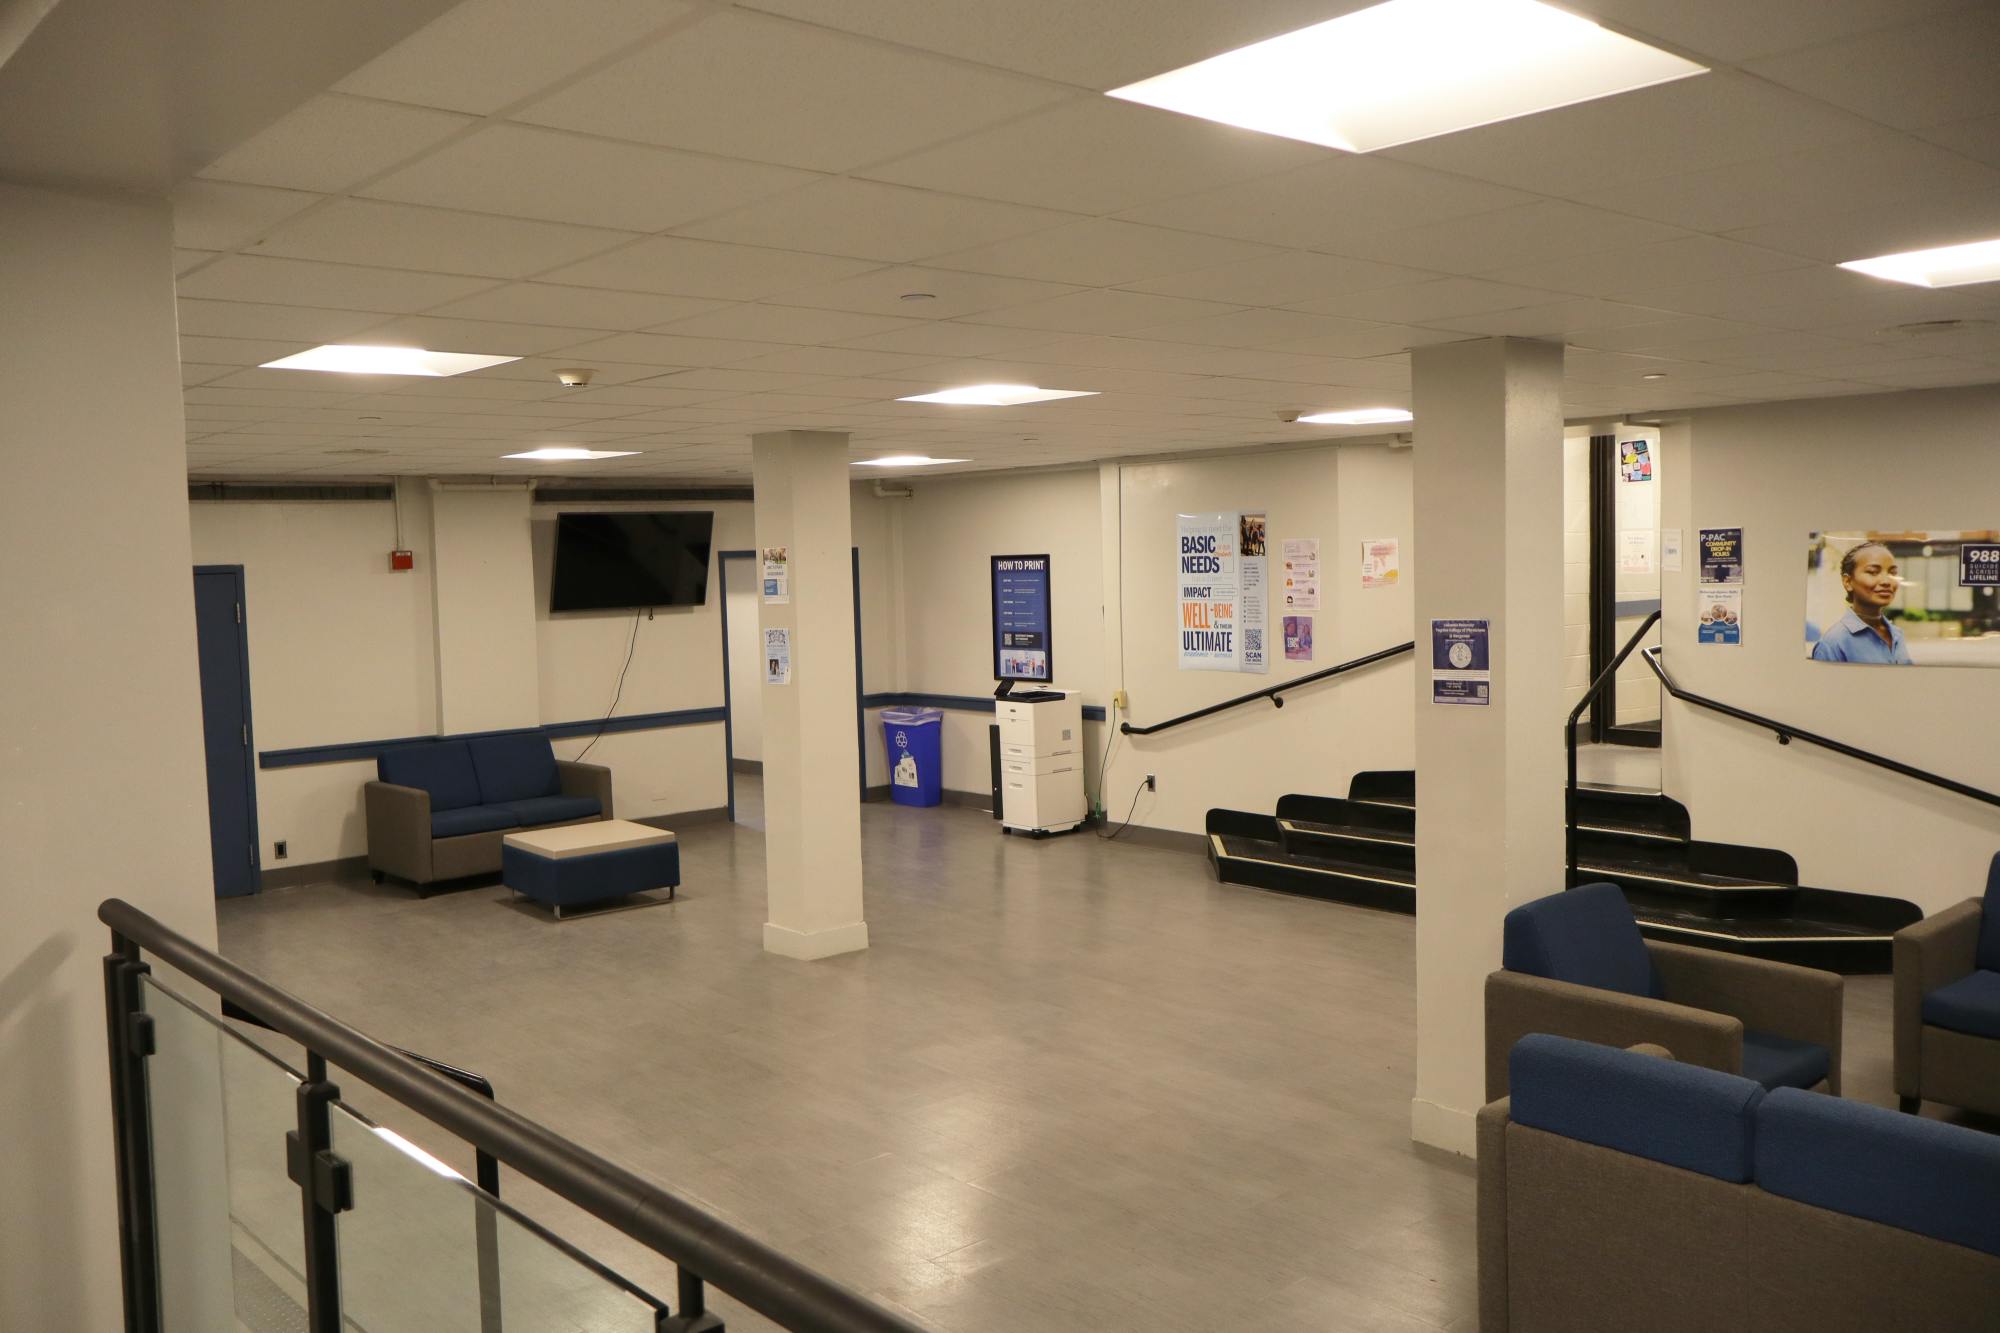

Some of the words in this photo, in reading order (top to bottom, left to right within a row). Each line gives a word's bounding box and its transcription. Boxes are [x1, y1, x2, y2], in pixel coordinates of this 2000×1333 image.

[1701, 533, 1726, 542] P-PAC
[1182, 536, 1216, 553] BASIC
[1970, 550, 1999, 562] 988
[998, 560, 1014, 571] HOW
[1015, 560, 1023, 570] TO
[1024, 560, 1044, 570] PRINT
[1182, 556, 1220, 573] NEEDS
[1184, 586, 1211, 598] IMPACT
[1183, 631, 1232, 652] ULTIMATE
